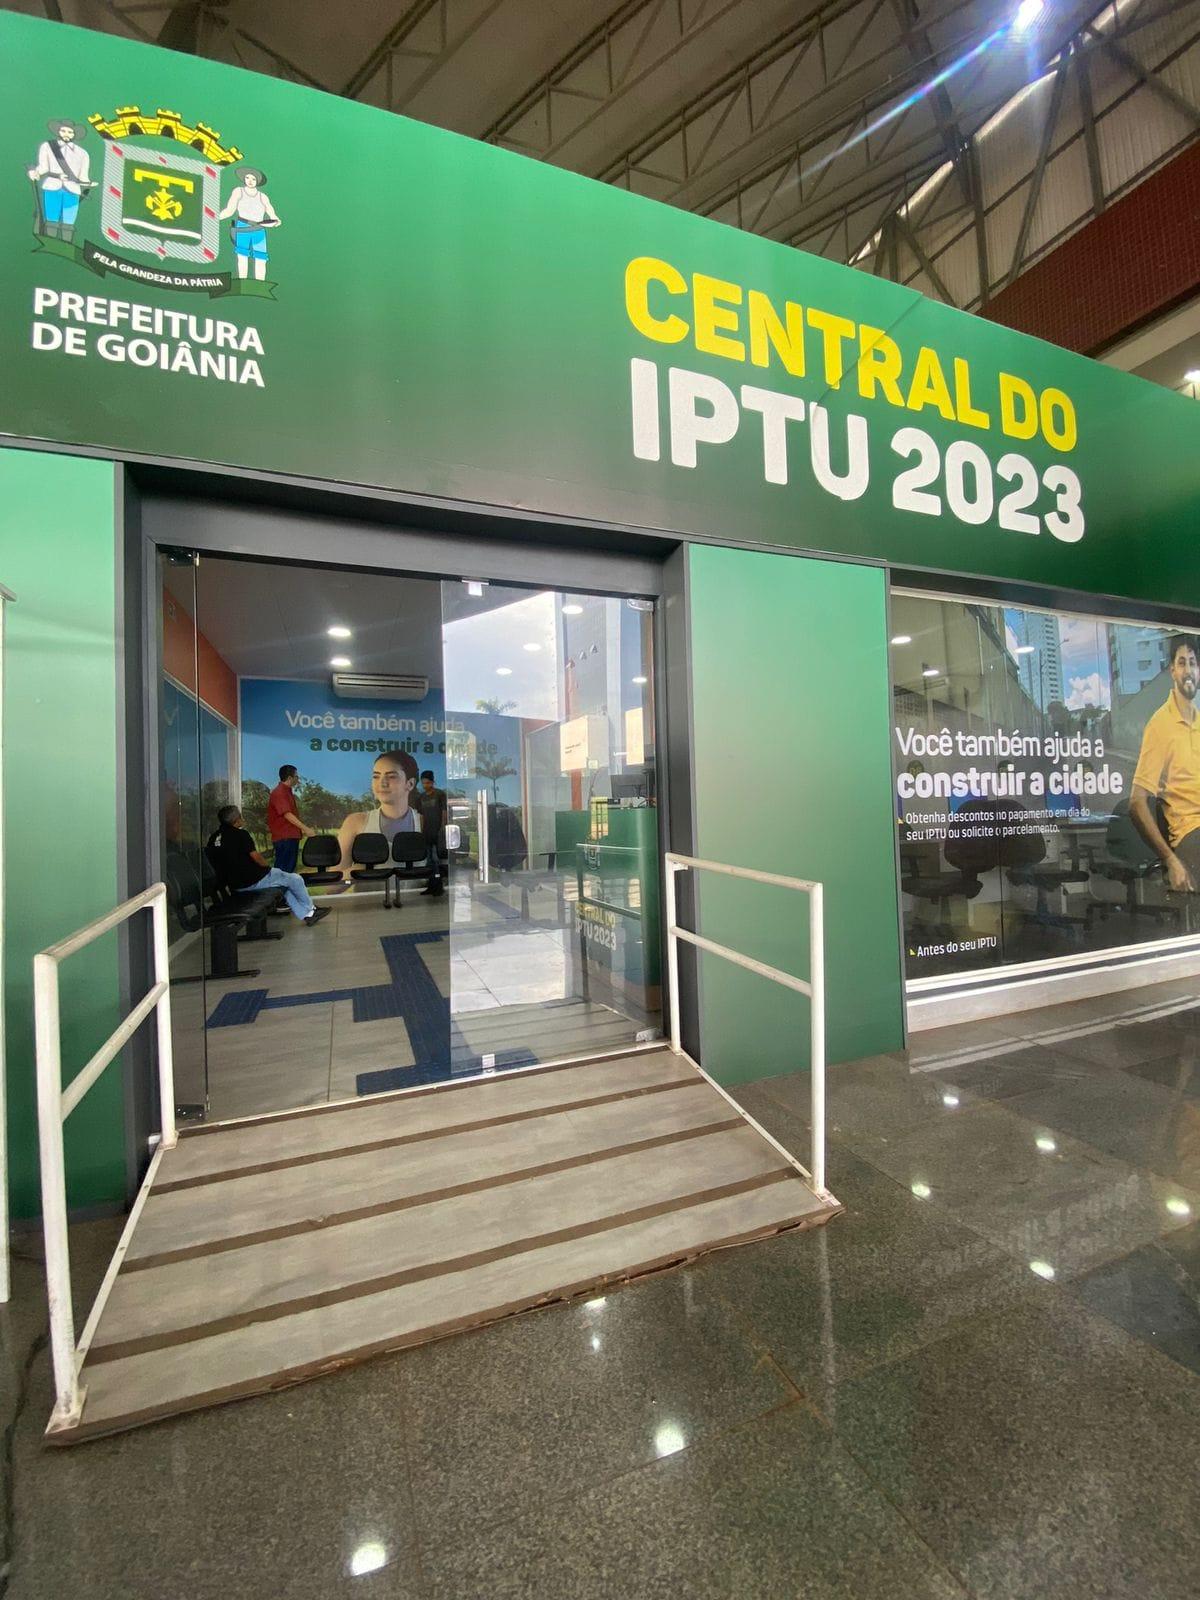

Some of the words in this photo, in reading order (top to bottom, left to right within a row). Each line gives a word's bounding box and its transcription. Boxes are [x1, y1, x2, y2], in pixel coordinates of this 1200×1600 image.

[93, 252, 117, 268] PELA
[119, 264, 172, 284] GRANDEZA
[173, 277, 189, 286] DA
[190, 277, 223, 287] PÁTRIA
[34, 287, 265, 355] PREFEITURA
[32, 322, 87, 356] DE
[97, 334, 265, 387] GOIÂNIA
[625, 257, 990, 430] CENTRAL
[999, 372, 1077, 452] DO
[631, 358, 870, 501] IPTU
[890, 427, 1085, 543] 2023
[285, 710, 334, 729] Você
[339, 713, 416, 732] também
[420, 716, 465, 737] ajuda
[310, 738, 323, 752] a
[326, 737, 420, 754] construir
[423, 741, 434, 754] a
[895, 727, 953, 757] Você
[955, 729, 1041, 757] também
[1044, 731, 1092, 764] ajuda
[1095, 738, 1104, 757] a
[897, 764, 1026, 798] construir
[1030, 772, 1045, 796] a
[1049, 764, 1124, 795] cidade
[905, 811, 946, 825] Obtenha
[948, 808, 995, 823] descontos
[996, 809, 1007, 821] no
[1008, 807, 1054, 823] pagamento
[1055, 808, 1067, 818] em
[1068, 806, 1080, 817] dia
[1081, 806, 1090, 817] do
[906, 829, 924, 841] seu
[926, 827, 947, 840] IPTU
[948, 828, 960, 839] ou
[962, 825, 994, 838] solicite
[1002, 823, 1060, 838] parcelamento.
[575, 918, 593, 939] IPTU
[593, 924, 617, 951] 2023
[917, 945, 945, 957] Antes
[946, 941, 958, 953] do
[960, 940, 976, 951] seu
[977, 936, 997, 949] IPTU
